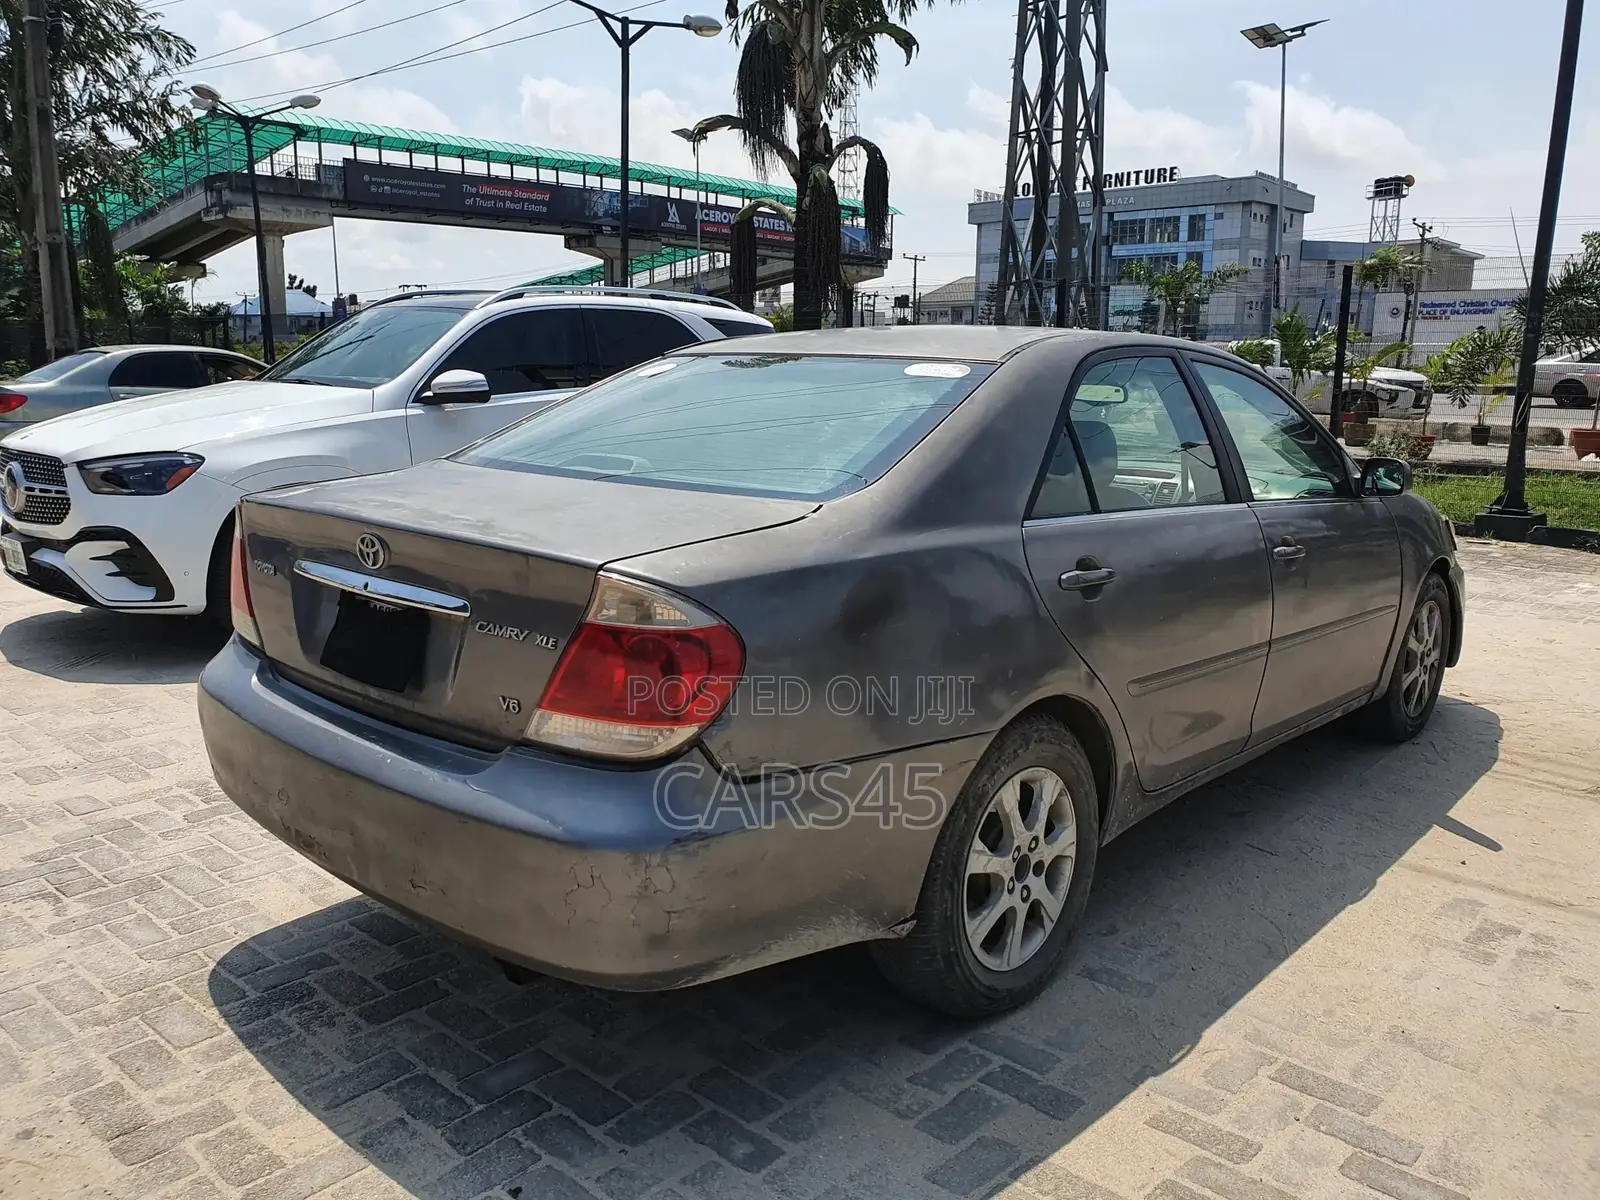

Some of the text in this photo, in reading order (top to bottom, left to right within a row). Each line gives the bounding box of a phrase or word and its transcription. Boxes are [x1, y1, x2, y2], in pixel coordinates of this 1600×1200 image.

[1082, 166, 1178, 191] FRNITURE
[462, 184, 550, 201] The Ultimate Standard
[465, 197, 548, 213] of Trust in Real Estate
[1105, 196, 1135, 206] PLAZA
[753, 216, 786, 231] STATES
[1450, 307, 1497, 315] ENLARGEMENT
[475, 621, 557, 649] CAMRY XLE
[499, 696, 520, 713] V6
